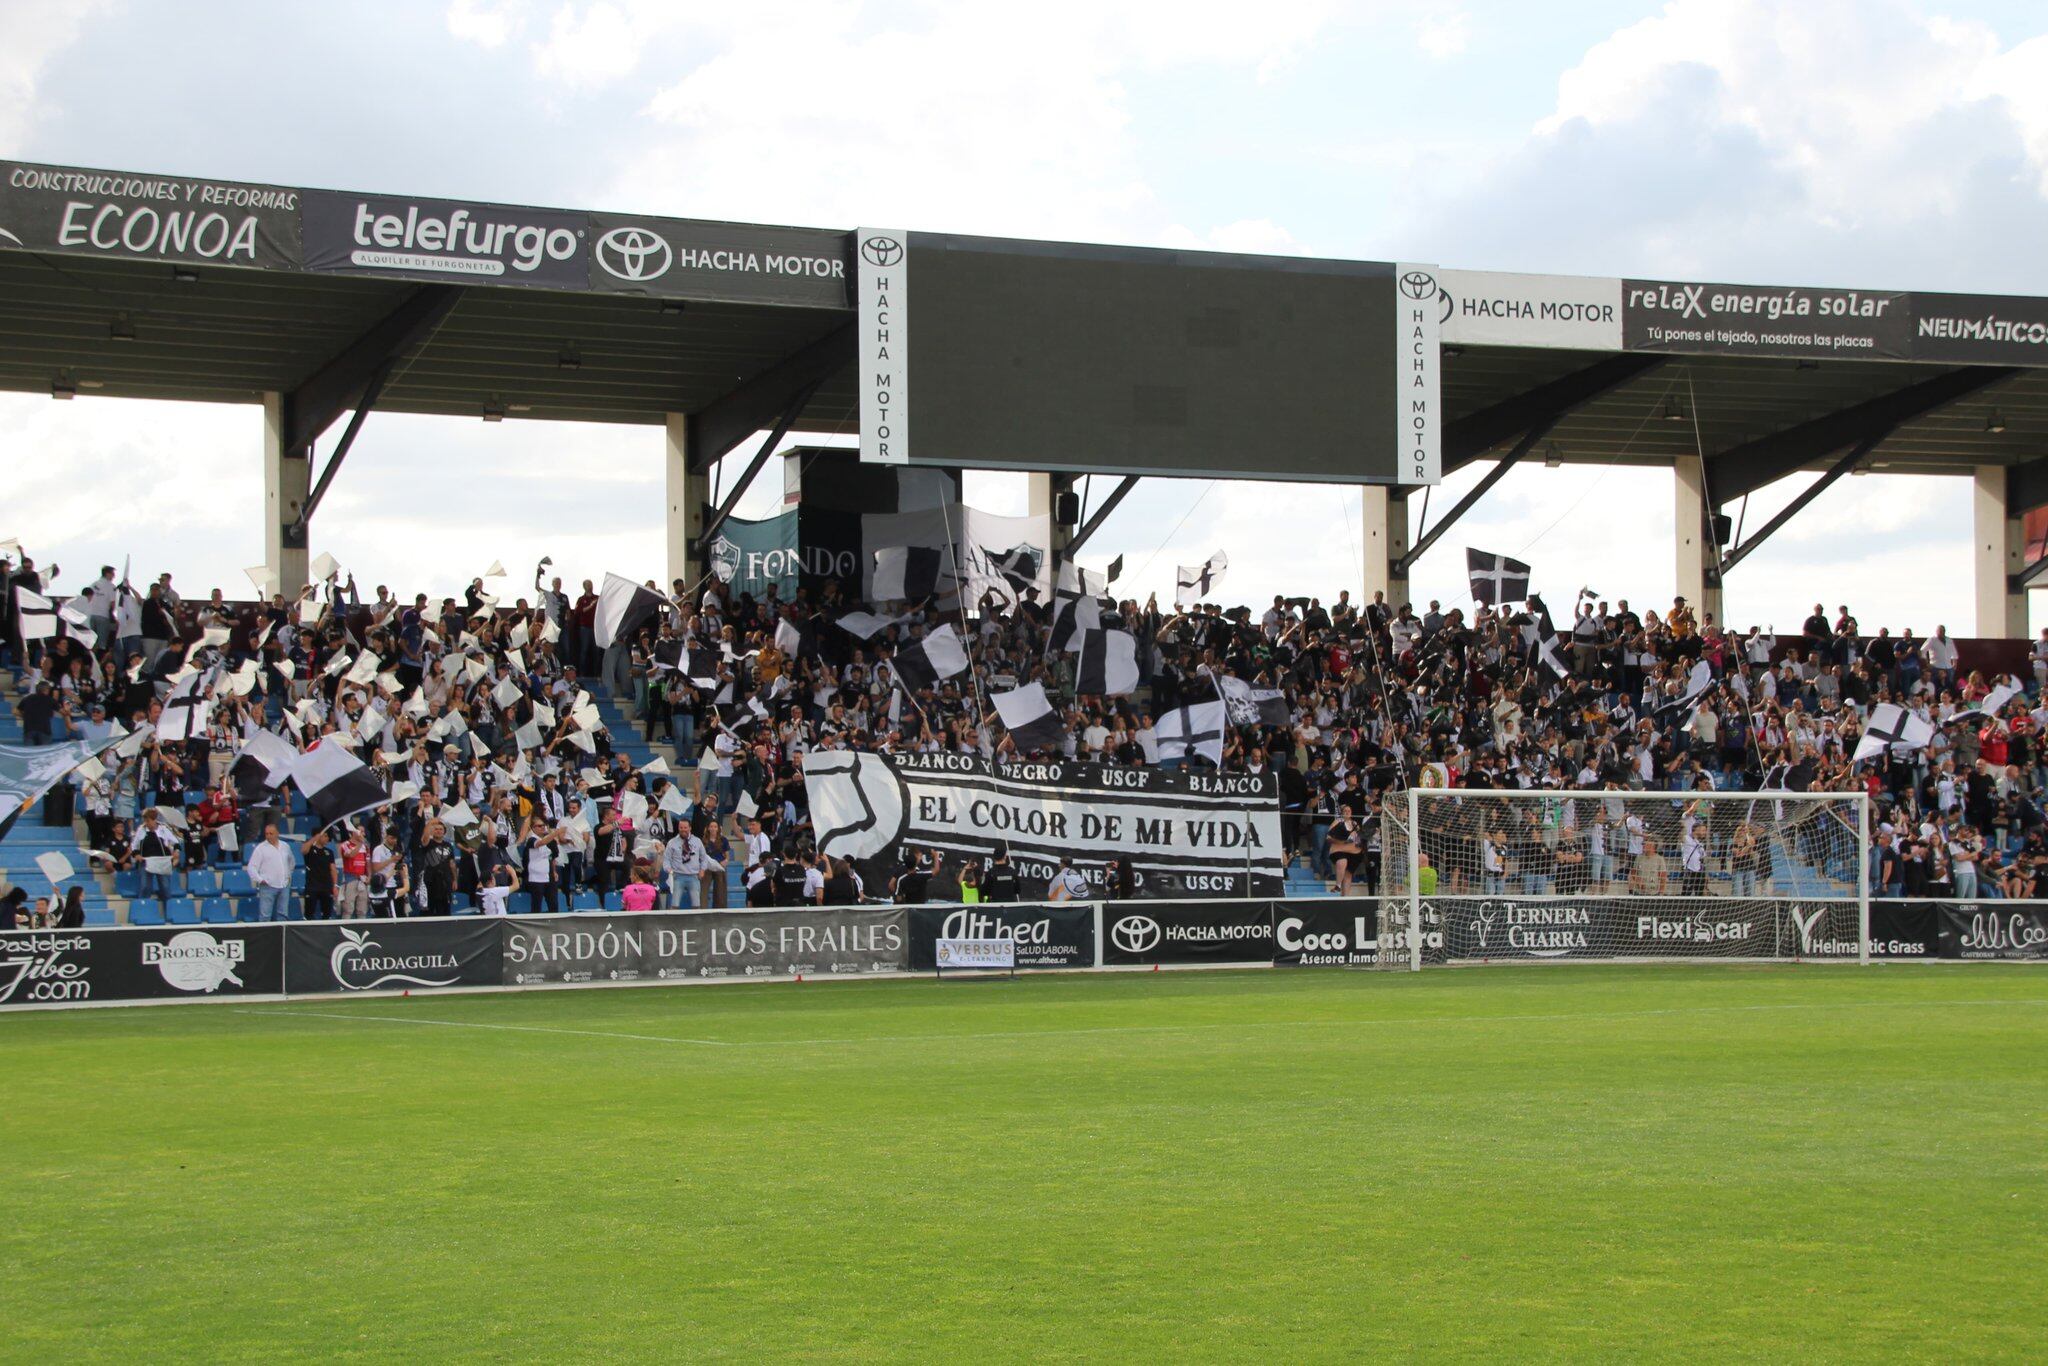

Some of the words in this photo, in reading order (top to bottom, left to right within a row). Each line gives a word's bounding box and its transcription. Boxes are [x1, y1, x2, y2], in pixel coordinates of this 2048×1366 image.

[10, 168, 177, 201] CONSTRUCCIONES
[185, 185, 196, 202] Y
[201, 186, 298, 211] REFORMAS
[58, 201, 259, 259] ECONOA
[353, 203, 577, 272] telefurgo
[361, 254, 410, 265] ALQUILER
[415, 258, 427, 266] DE
[431, 260, 497, 271] FURGONETAS
[681, 249, 760, 273] HACHA
[765, 255, 845, 278] MOTOR
[1462, 298, 1535, 319] HACHA
[1540, 302, 1613, 323] MOTOR
[1628, 285, 1707, 319] relaX
[1710, 291, 1810, 320] energía
[1818, 293, 1889, 317] solar
[877, 277, 890, 360] HACHA
[1918, 315, 2048, 344] NEUMÁTICO
[1413, 310, 1424, 387] HACHA
[1647, 327, 1661, 339] Tú
[1664, 330, 1701, 343] pones
[1704, 330, 1715, 341] el
[1717, 331, 1758, 345] tejado,
[1761, 334, 1811, 345] nosotros
[1814, 334, 1831, 346] las
[1833, 335, 1873, 349] placas
[876, 373, 890, 456] MOTOR
[1412, 401, 1425, 478] MOTOR
[746, 545, 856, 580] FONDO
[1101, 769, 1149, 787] USCF
[1189, 775, 1263, 793] BLANCO
[919, 795, 957, 824] EL
[969, 800, 1068, 839] COLOR
[1080, 813, 1122, 841] DE
[1135, 817, 1173, 845] MI
[1186, 820, 1264, 848] VIDA
[1186, 875, 1234, 891] USCF
[1503, 902, 1590, 924] TERNERA
[509, 922, 642, 963] SARDÓN
[658, 929, 698, 957] DE
[711, 926, 766, 955] LOS
[779, 923, 901, 953] FRAILES
[1166, 926, 1217, 940] HACHA
[1220, 925, 1272, 939] MOTOR
[1277, 917, 1347, 951] Coco
[1508, 925, 1588, 947] CHARRA
[145, 942, 241, 961] BROCENSE
[953, 944, 1011, 955] VERSUS
[1042, 946, 1078, 954] LABORAL
[1299, 953, 1345, 965] Asesora
[1888, 940, 1925, 954] Grass
[348, 954, 459, 971] TARDAGUILA
[27, 980, 91, 999] .com
